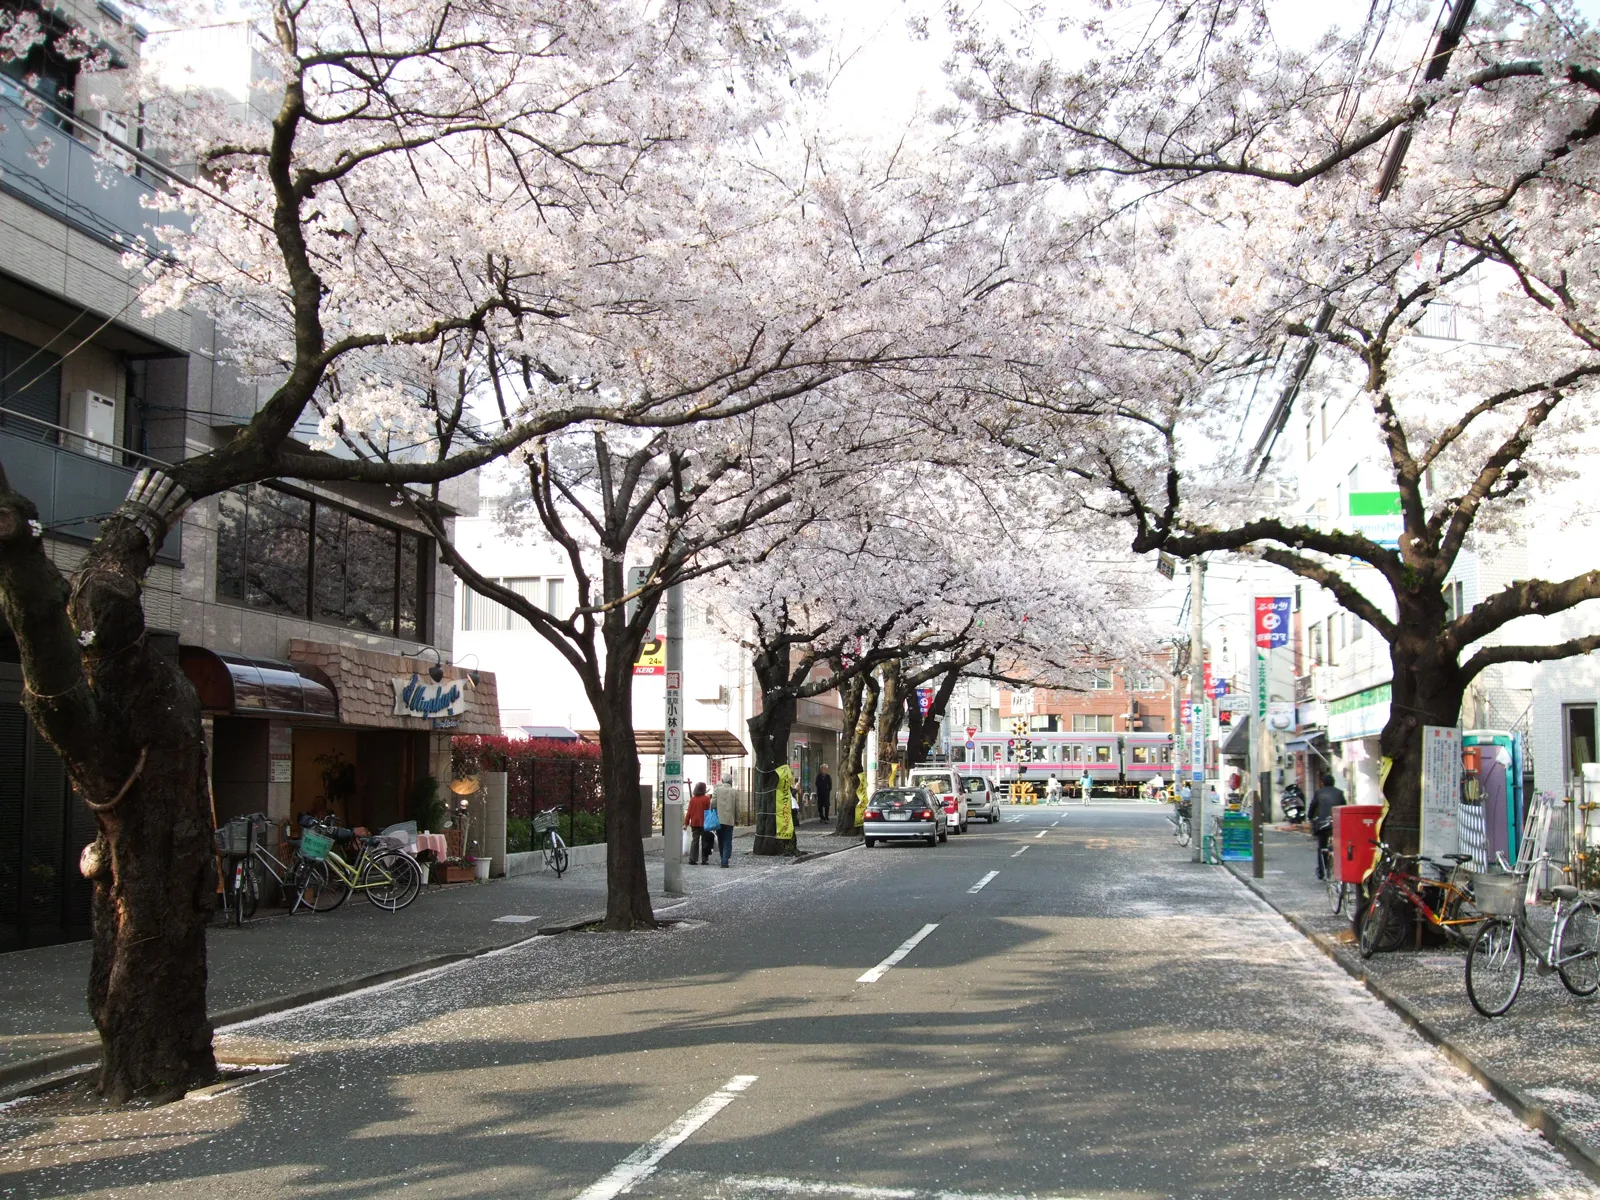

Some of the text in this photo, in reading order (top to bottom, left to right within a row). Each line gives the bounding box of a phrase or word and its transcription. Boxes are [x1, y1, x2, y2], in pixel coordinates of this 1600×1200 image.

[1352, 522, 1402, 533] FamilyMa
[635, 666, 655, 674] KEIO
[667, 674, 679, 688] 質
[667, 703, 678, 728] 小林
